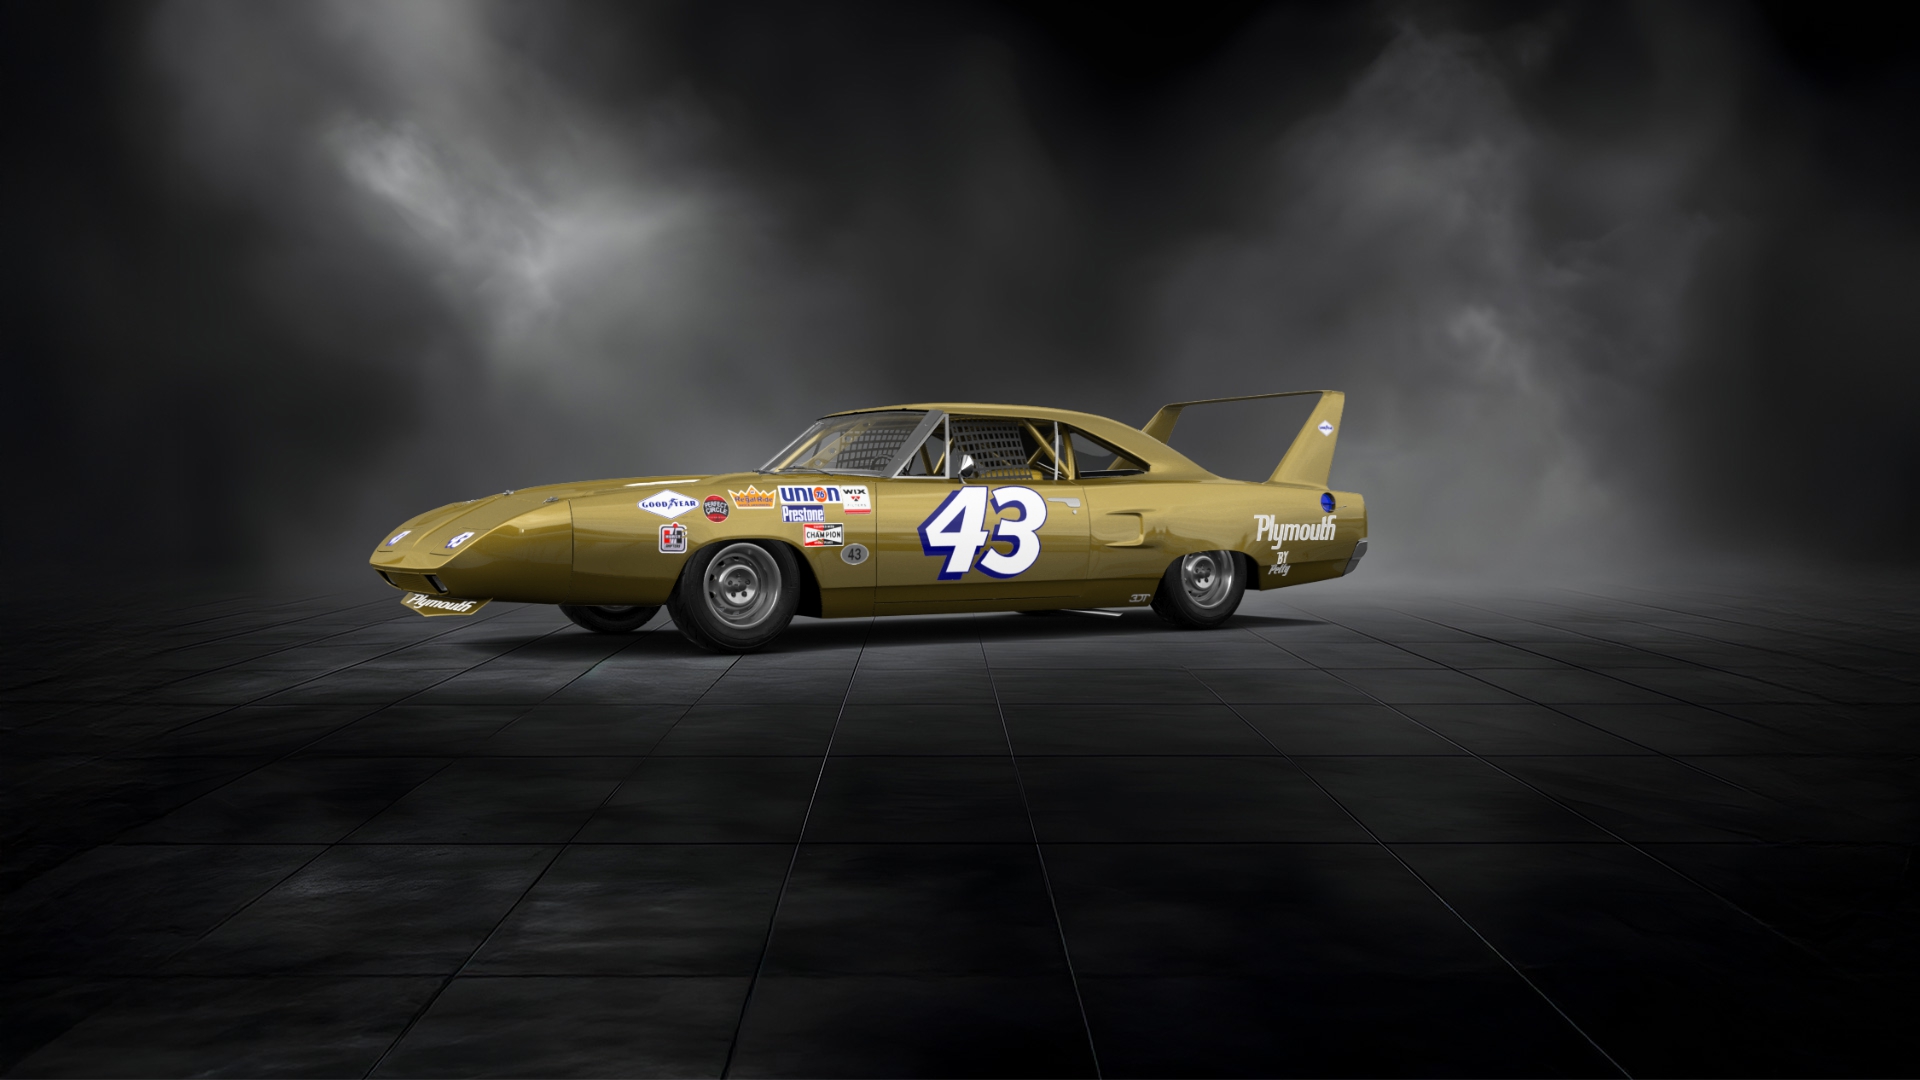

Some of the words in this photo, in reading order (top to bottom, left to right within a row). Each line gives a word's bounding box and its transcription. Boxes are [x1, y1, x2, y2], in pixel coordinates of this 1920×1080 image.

[642, 498, 696, 509] GOODYEAR
[704, 500, 727, 509] PERFECT
[705, 506, 727, 516] CIRCLE
[782, 505, 824, 522] Prestone
[806, 531, 841, 539] CHAMPION
[917, 485, 1047, 580] 43
[1254, 514, 1337, 550] Plymouth
[848, 548, 862, 561] 43
[1277, 551, 1289, 565] BY
[1268, 564, 1291, 577] Petty
[406, 593, 477, 612] Plymouth
